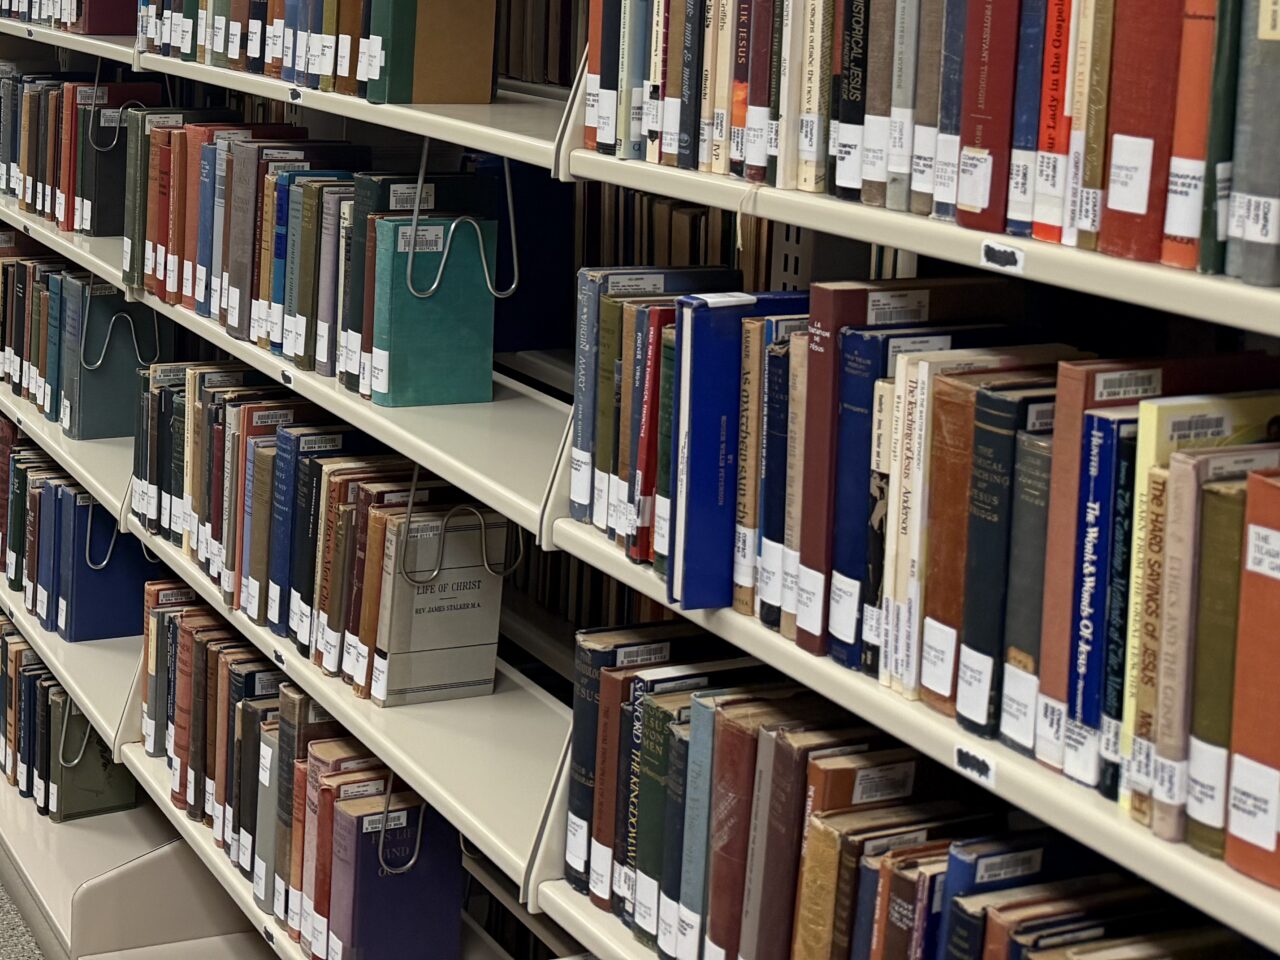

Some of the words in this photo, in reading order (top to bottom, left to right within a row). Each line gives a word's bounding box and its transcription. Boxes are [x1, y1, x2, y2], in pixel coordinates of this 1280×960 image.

[739, 4, 748, 23] LIK
[738, 27, 748, 64] JESUS
[981, 4, 993, 62] PROTESTANT
[1049, 52, 1061, 74] the
[681, 66, 692, 105] master
[848, 62, 863, 101] JESUS
[977, 65, 988, 109] THOUGHT
[1048, 79, 1059, 92] in
[1045, 95, 1060, 130] Lady
[579, 314, 590, 351] VIRGIN
[577, 355, 586, 392] MARY
[908, 379, 919, 398] The
[904, 400, 918, 441] Teaching
[904, 442, 915, 453] of
[903, 453, 915, 480] Jesus
[900, 486, 913, 535] Anderson
[1150, 480, 1167, 508] The
[1085, 501, 1101, 524] The
[1137, 492, 1148, 532] LEARN
[325, 518, 335, 555] Have
[1082, 527, 1100, 561] Work
[1147, 511, 1165, 554] HARD
[1081, 562, 1097, 574] &
[1135, 536, 1146, 570] FROM
[416, 584, 436, 596] LIFE
[438, 583, 449, 593] OF
[451, 580, 482, 591] CHRIST
[1078, 576, 1097, 617] Words
[1134, 575, 1144, 599] THE
[1144, 558, 1163, 619] SAYINGS
[427, 605, 445, 614] JAMES
[446, 602, 471, 612] STALKER
[1131, 601, 1143, 639] GREAT
[1078, 619, 1094, 640] Of
[1143, 622, 1159, 642] of
[1165, 612, 1179, 645] AND
[1076, 640, 1092, 675] Jesus
[1128, 640, 1140, 699] TEACHER
[1140, 642, 1157, 688] JESUS
[1164, 650, 1178, 680] THE
[632, 681, 645, 744] SANFORD
[630, 749, 641, 774] THE
[627, 775, 641, 840] KINGDOM
